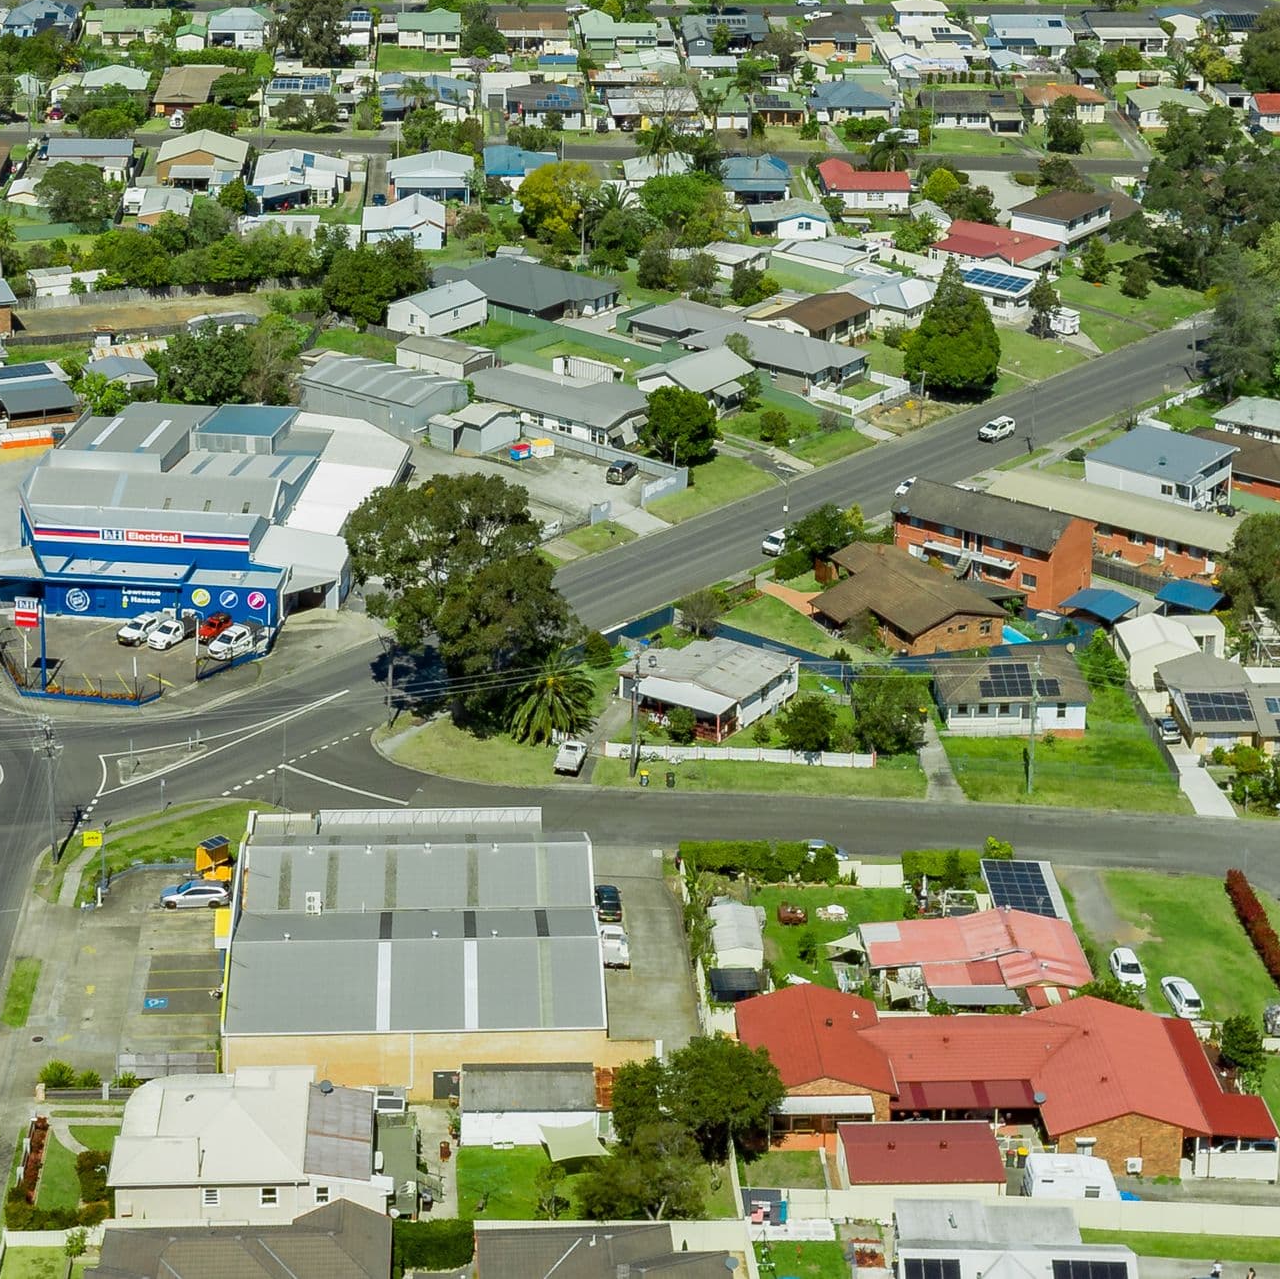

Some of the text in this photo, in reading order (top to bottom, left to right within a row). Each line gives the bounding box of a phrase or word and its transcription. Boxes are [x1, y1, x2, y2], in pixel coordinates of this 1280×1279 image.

[127, 531, 179, 543] Electrical
[122, 586, 161, 596] Lawrence
[130, 595, 161, 604] Hanson
